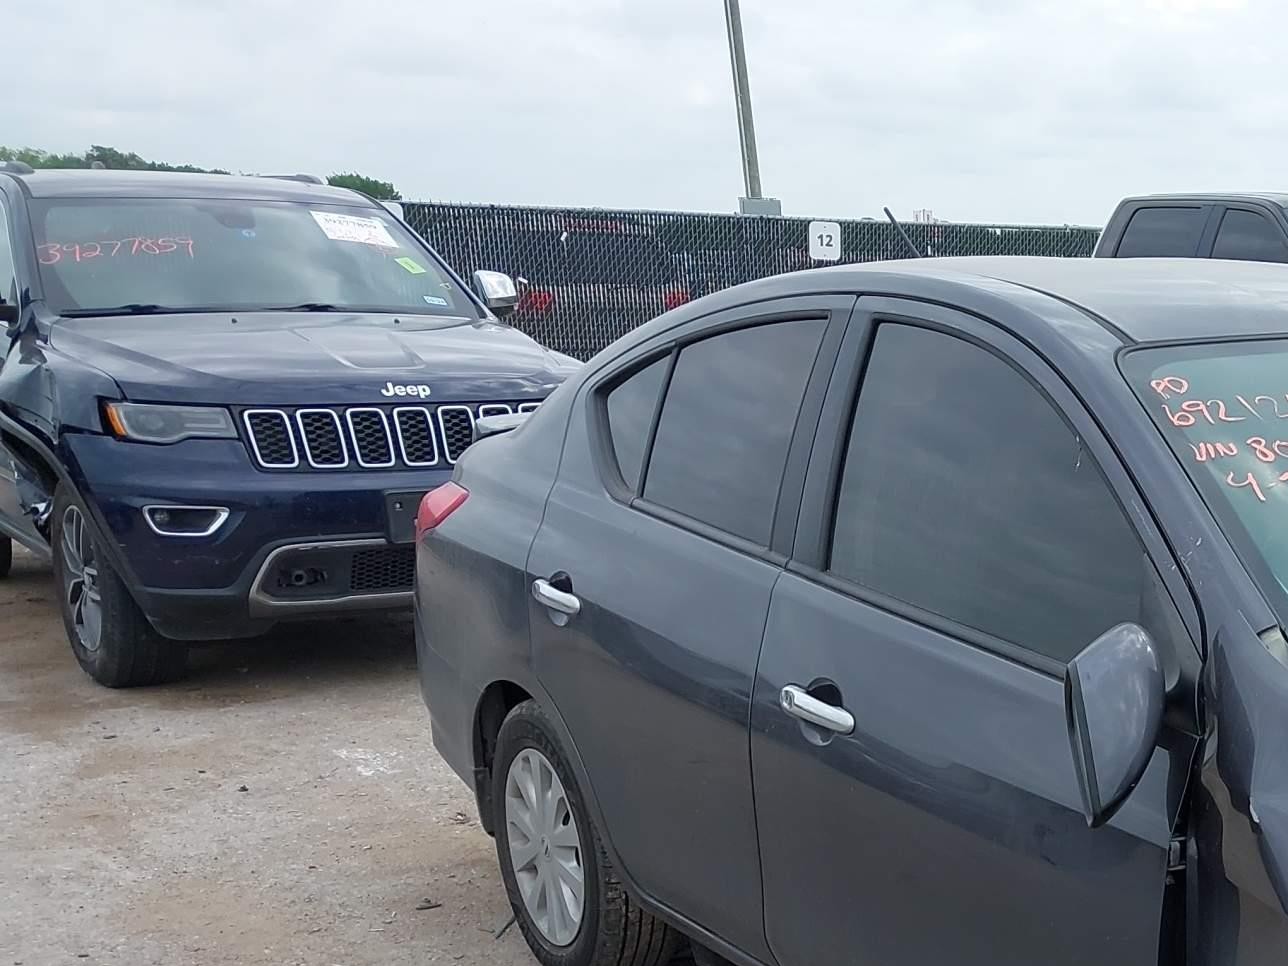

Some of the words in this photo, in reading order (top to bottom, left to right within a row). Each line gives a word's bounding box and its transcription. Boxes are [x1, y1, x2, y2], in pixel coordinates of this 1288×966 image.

[817, 233, 833, 248] 12
[37, 236, 194, 265] 39277859
[381, 382, 431, 399] Jeep
[1189, 442, 1239, 462] VIN
